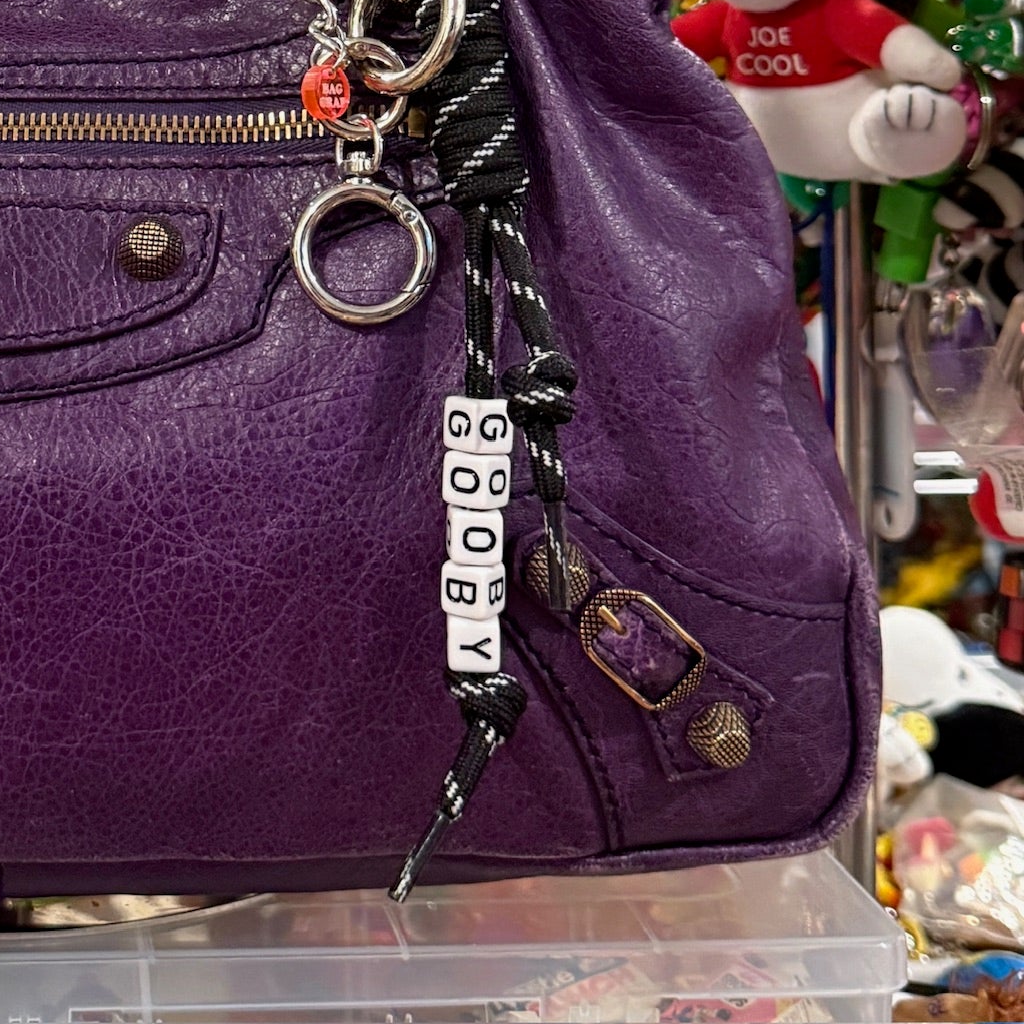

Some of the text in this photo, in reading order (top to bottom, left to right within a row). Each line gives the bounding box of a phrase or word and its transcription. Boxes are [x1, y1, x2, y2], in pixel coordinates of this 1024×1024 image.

[747, 26, 792, 48] JOE
[736, 52, 809, 76] COOL
[321, 83, 343, 95] BAG
